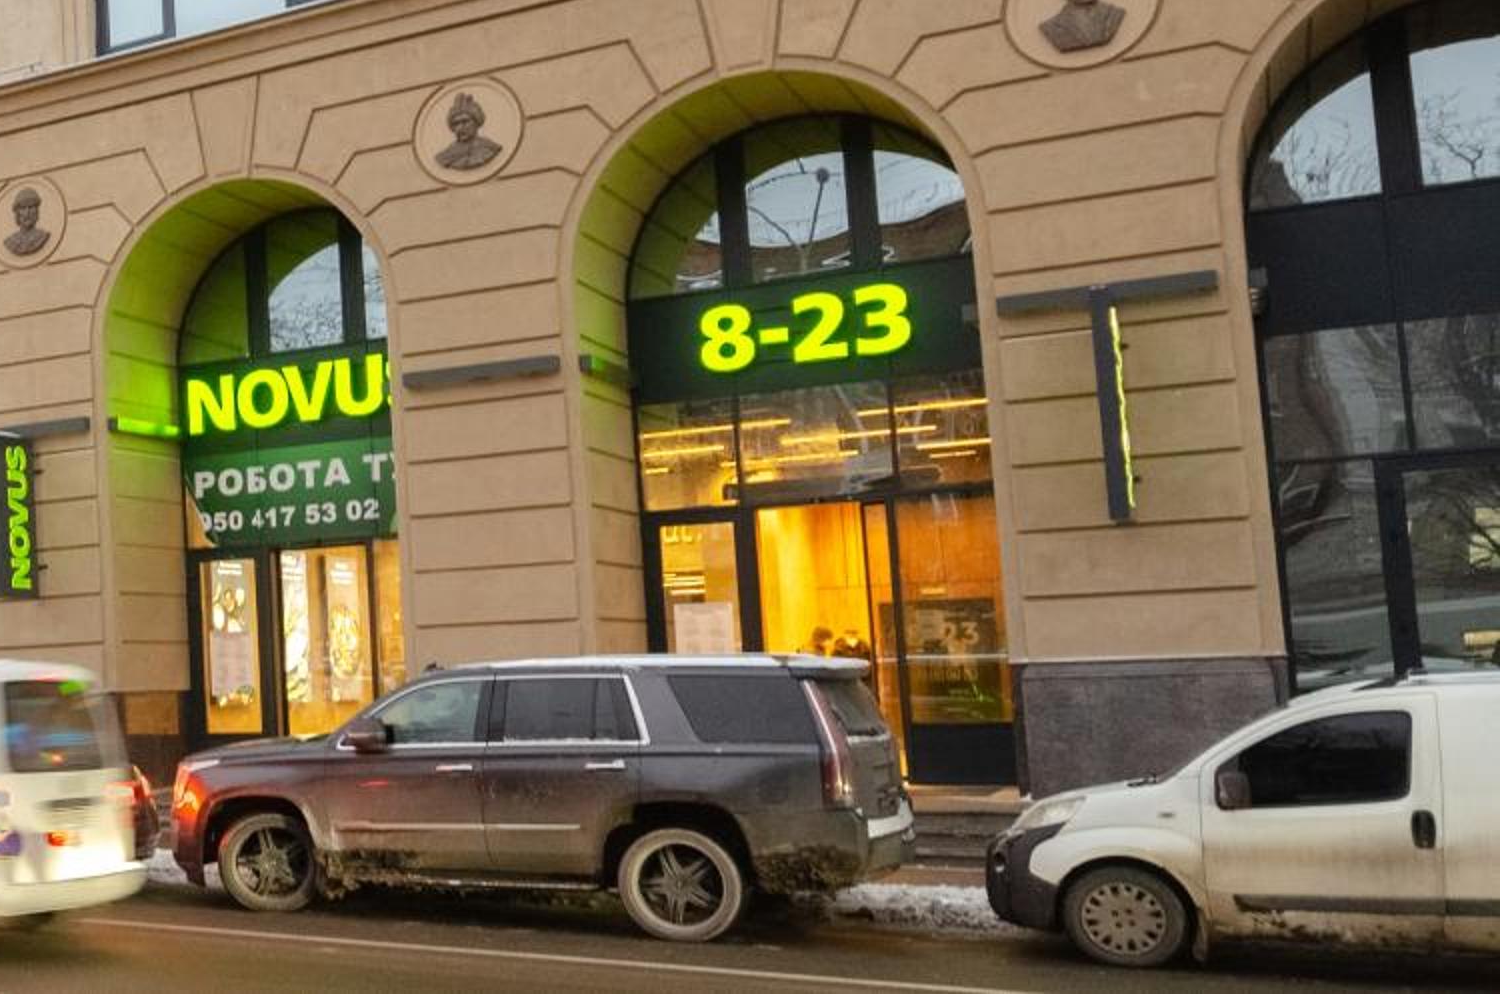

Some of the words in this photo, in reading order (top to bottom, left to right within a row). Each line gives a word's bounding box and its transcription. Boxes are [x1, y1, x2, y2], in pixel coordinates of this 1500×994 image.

[700, 283, 912, 372] 8-23
[194, 457, 351, 500] РОБОТА
[362, 450, 396, 483] Т
[5, 445, 32, 590] NOVUS
[251, 506, 296, 530] 417
[305, 502, 338, 525] 53
[346, 498, 380, 521] 02
